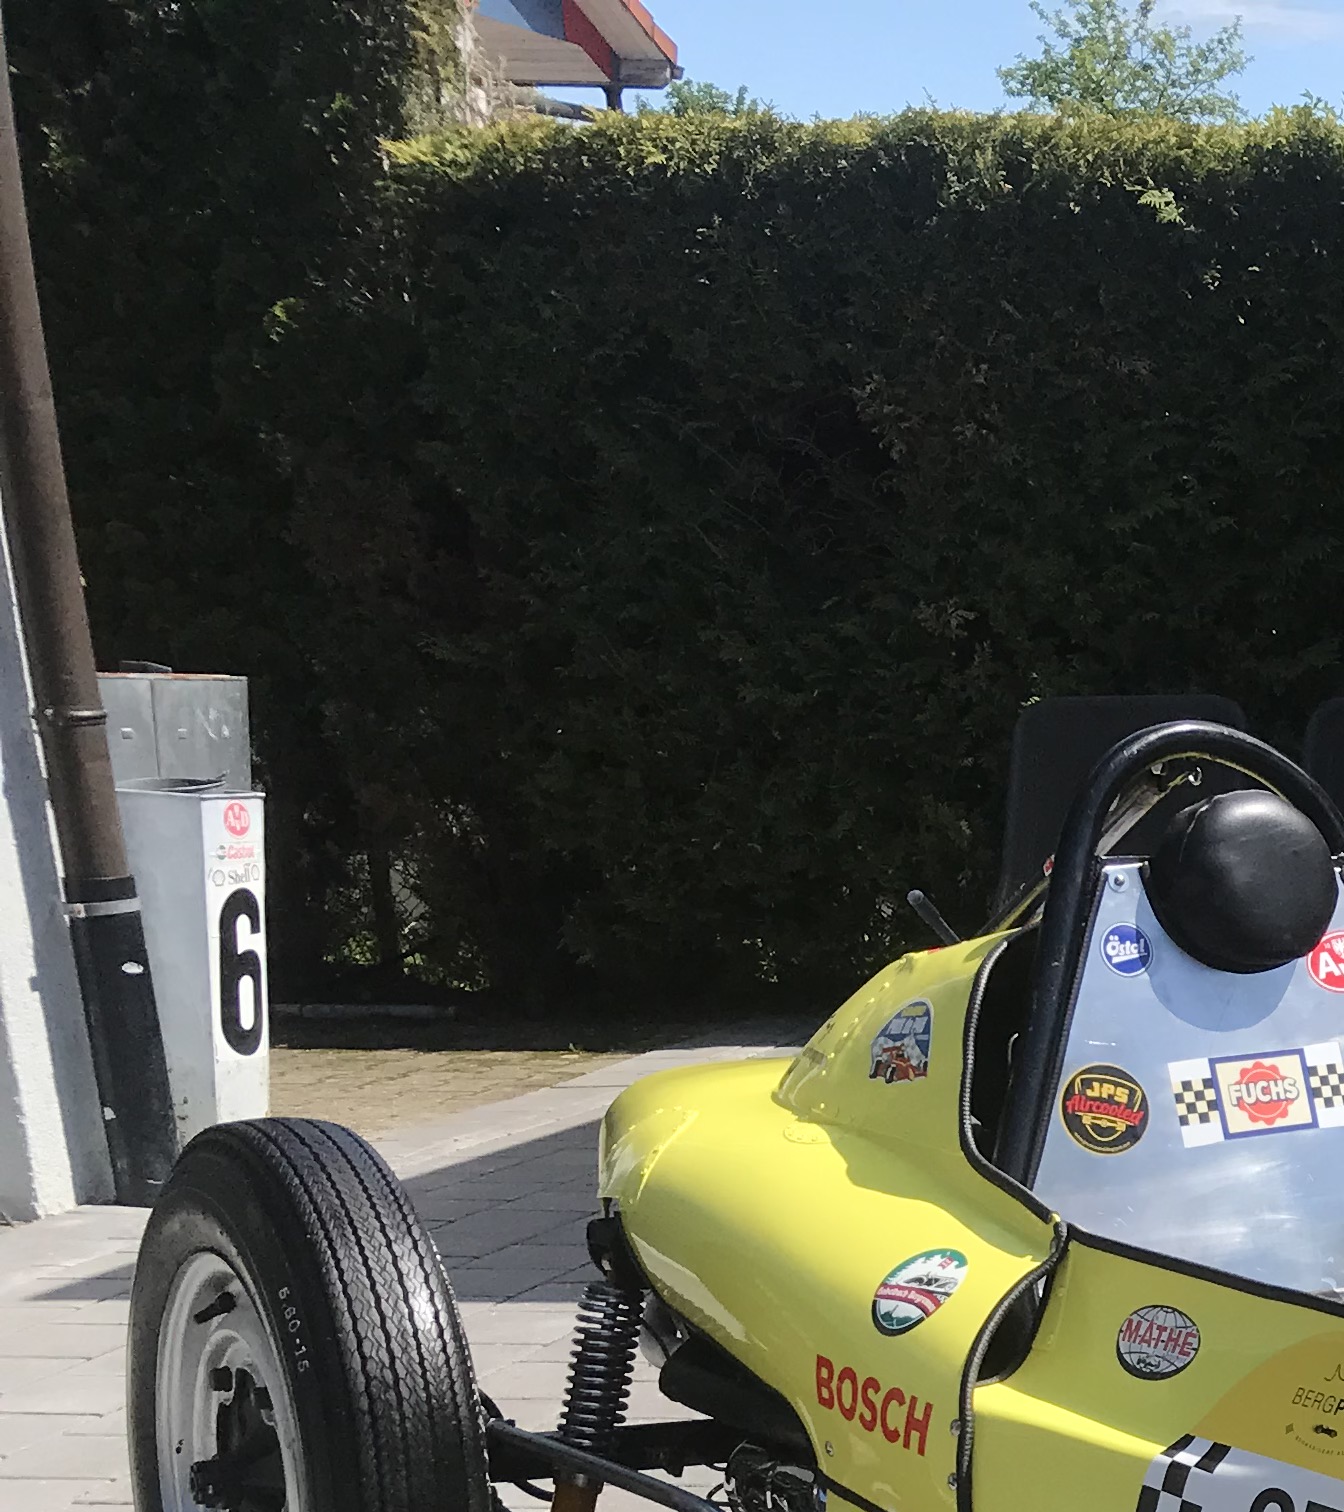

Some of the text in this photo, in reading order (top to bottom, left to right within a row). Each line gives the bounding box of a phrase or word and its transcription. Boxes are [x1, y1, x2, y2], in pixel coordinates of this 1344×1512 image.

[219, 888, 263, 1056] 6
[1085, 1081, 1130, 1104] JPS
[1228, 1077, 1300, 1107] FUCHS
[1066, 1093, 1145, 1127] Aircooled
[815, 1353, 934, 1457] BOSCH
